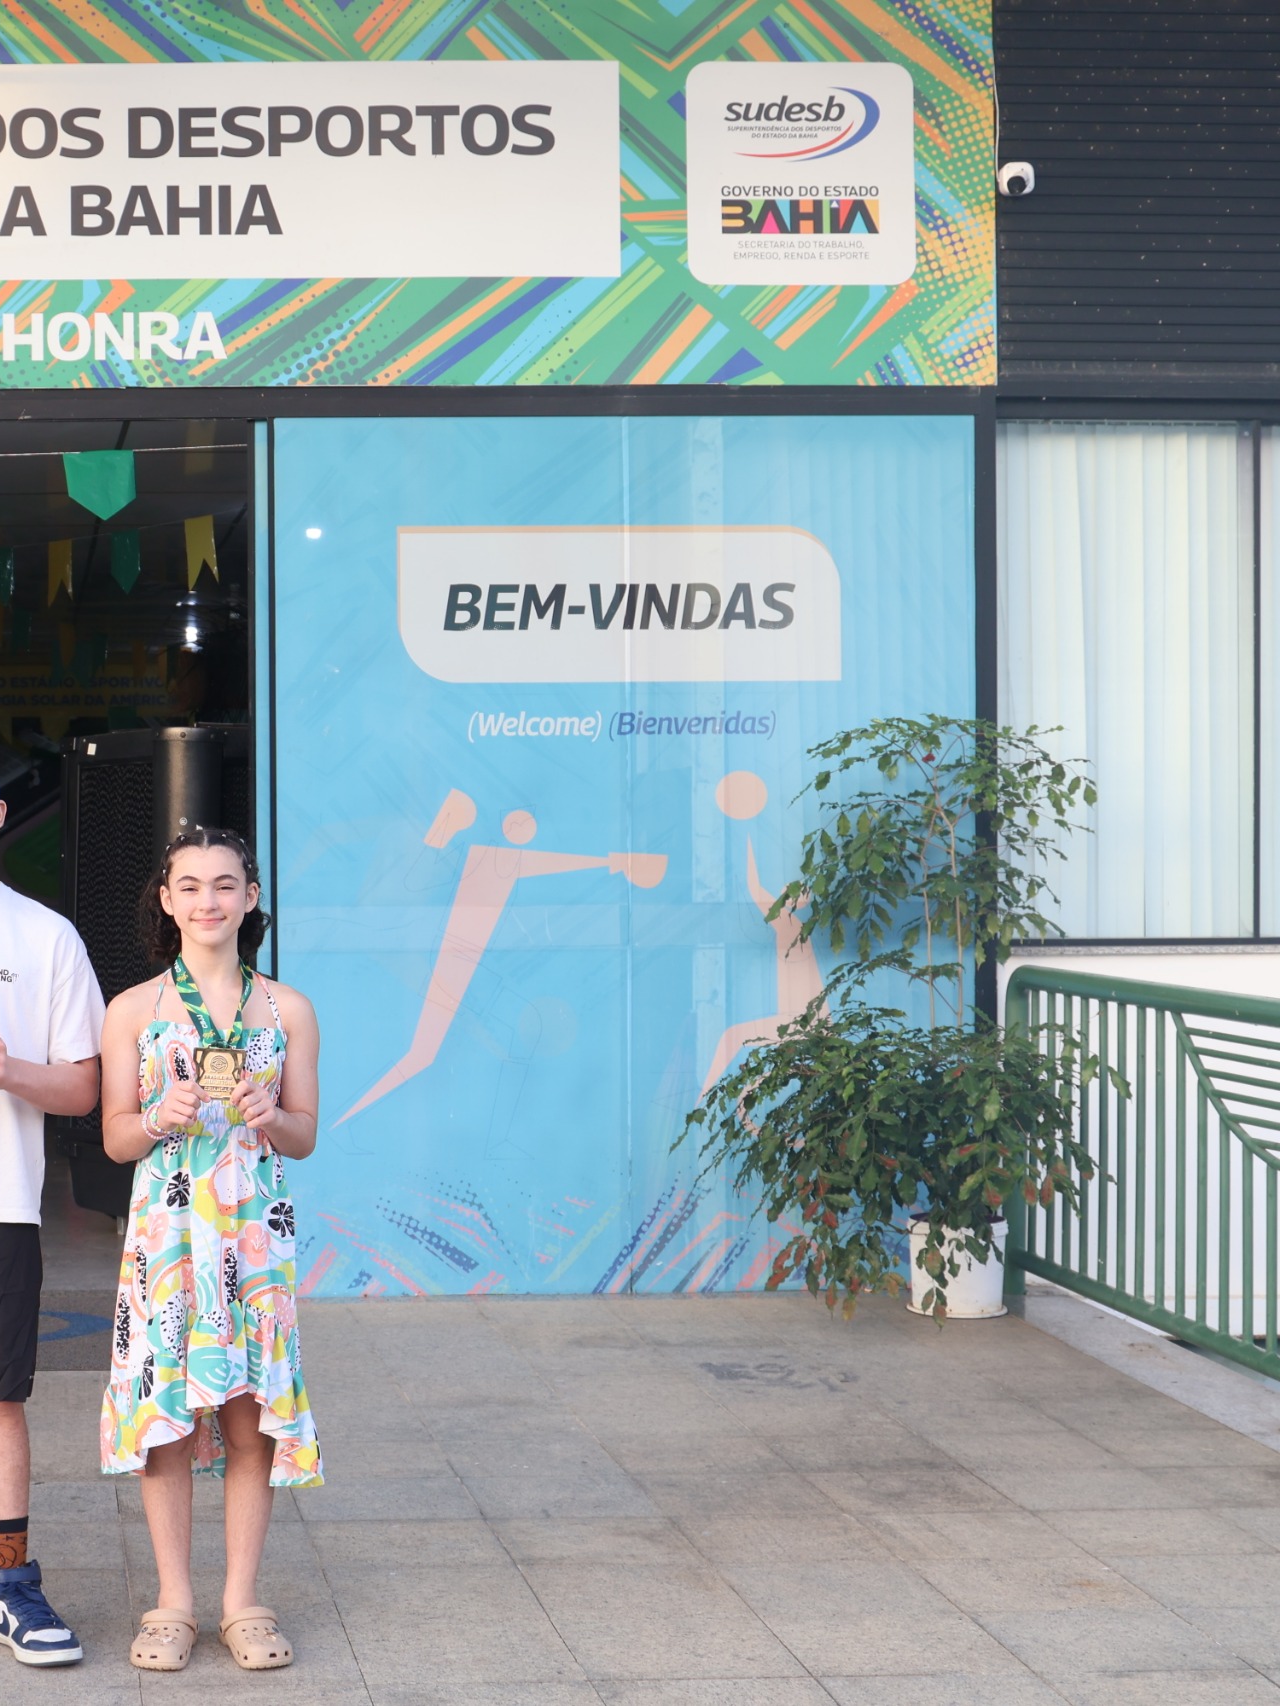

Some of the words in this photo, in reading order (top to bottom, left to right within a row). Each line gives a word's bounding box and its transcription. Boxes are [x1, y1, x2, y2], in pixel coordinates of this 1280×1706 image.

[724, 94, 846, 122] sudesb
[127, 103, 556, 159] DESPORTOS
[727, 124, 790, 132] SUPERINTENDÊNCIA
[721, 185, 794, 197] GOVERNO
[798, 185, 819, 197] DO
[824, 185, 880, 197] ESTADO
[69, 184, 284, 237] BAHIA
[721, 199, 880, 234] BAHIA
[733, 252, 781, 261] EMPREGO,
[784, 251, 816, 260] RENDA
[819, 252, 825, 260] E
[827, 251, 870, 260] ESPORTE
[738, 240, 795, 249] SECRETARIA
[798, 240, 812, 249] DO
[813, 240, 865, 250] TRABALHO,
[2, 310, 228, 362] HONRA
[443, 582, 796, 632] BEM-VINDAS
[31, 694, 80, 706] SOLAR
[84, 694, 105, 706] DA
[467, 710, 603, 743] (Welcome)
[608, 710, 777, 742] (Bienvenidas)
